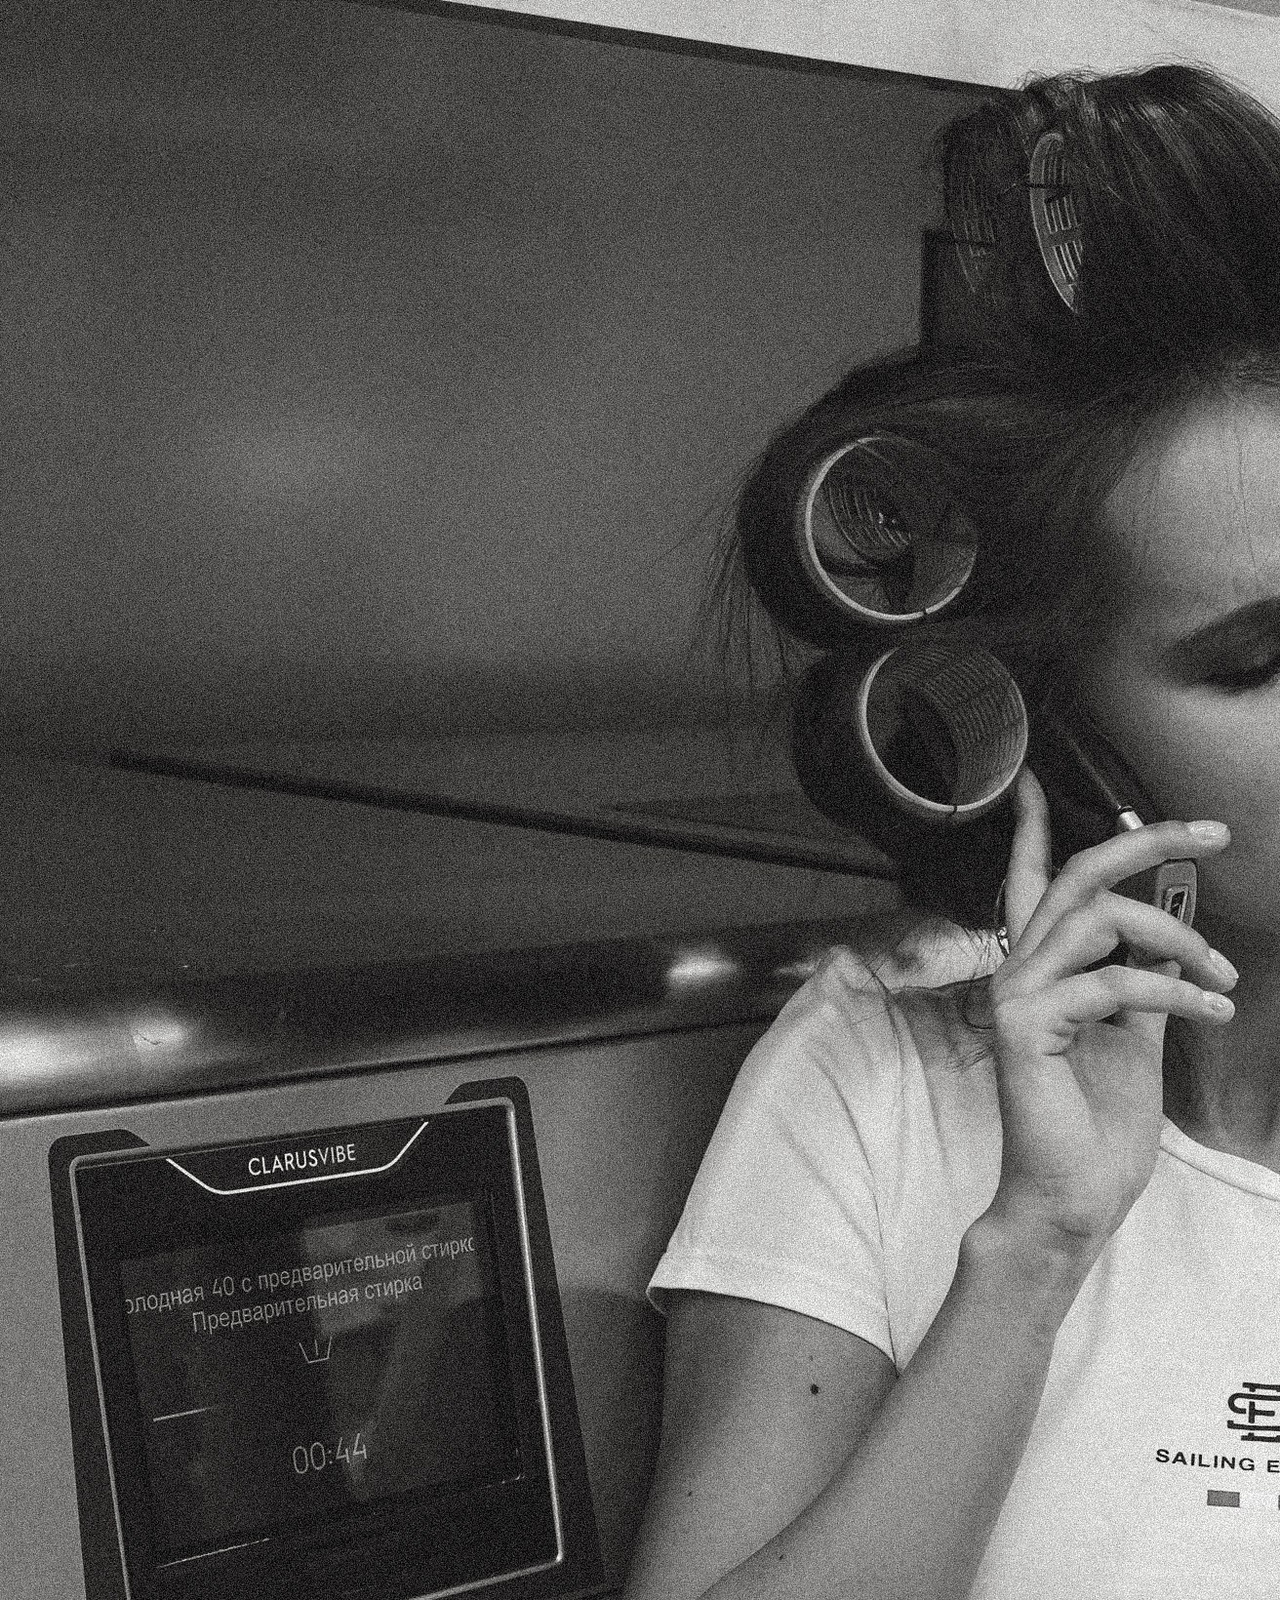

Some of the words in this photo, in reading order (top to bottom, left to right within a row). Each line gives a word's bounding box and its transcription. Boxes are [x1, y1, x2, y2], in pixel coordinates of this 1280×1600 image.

[248, 1143, 356, 1176] CLARUSVIBE
[212, 1276, 235, 1297] 40
[258, 1243, 417, 1293] предварительной
[192, 1287, 360, 1335] Предварительная
[364, 1275, 423, 1299] стирка
[292, 1432, 368, 1474] 00:44
[1155, 1448, 1255, 1472] SAILING
